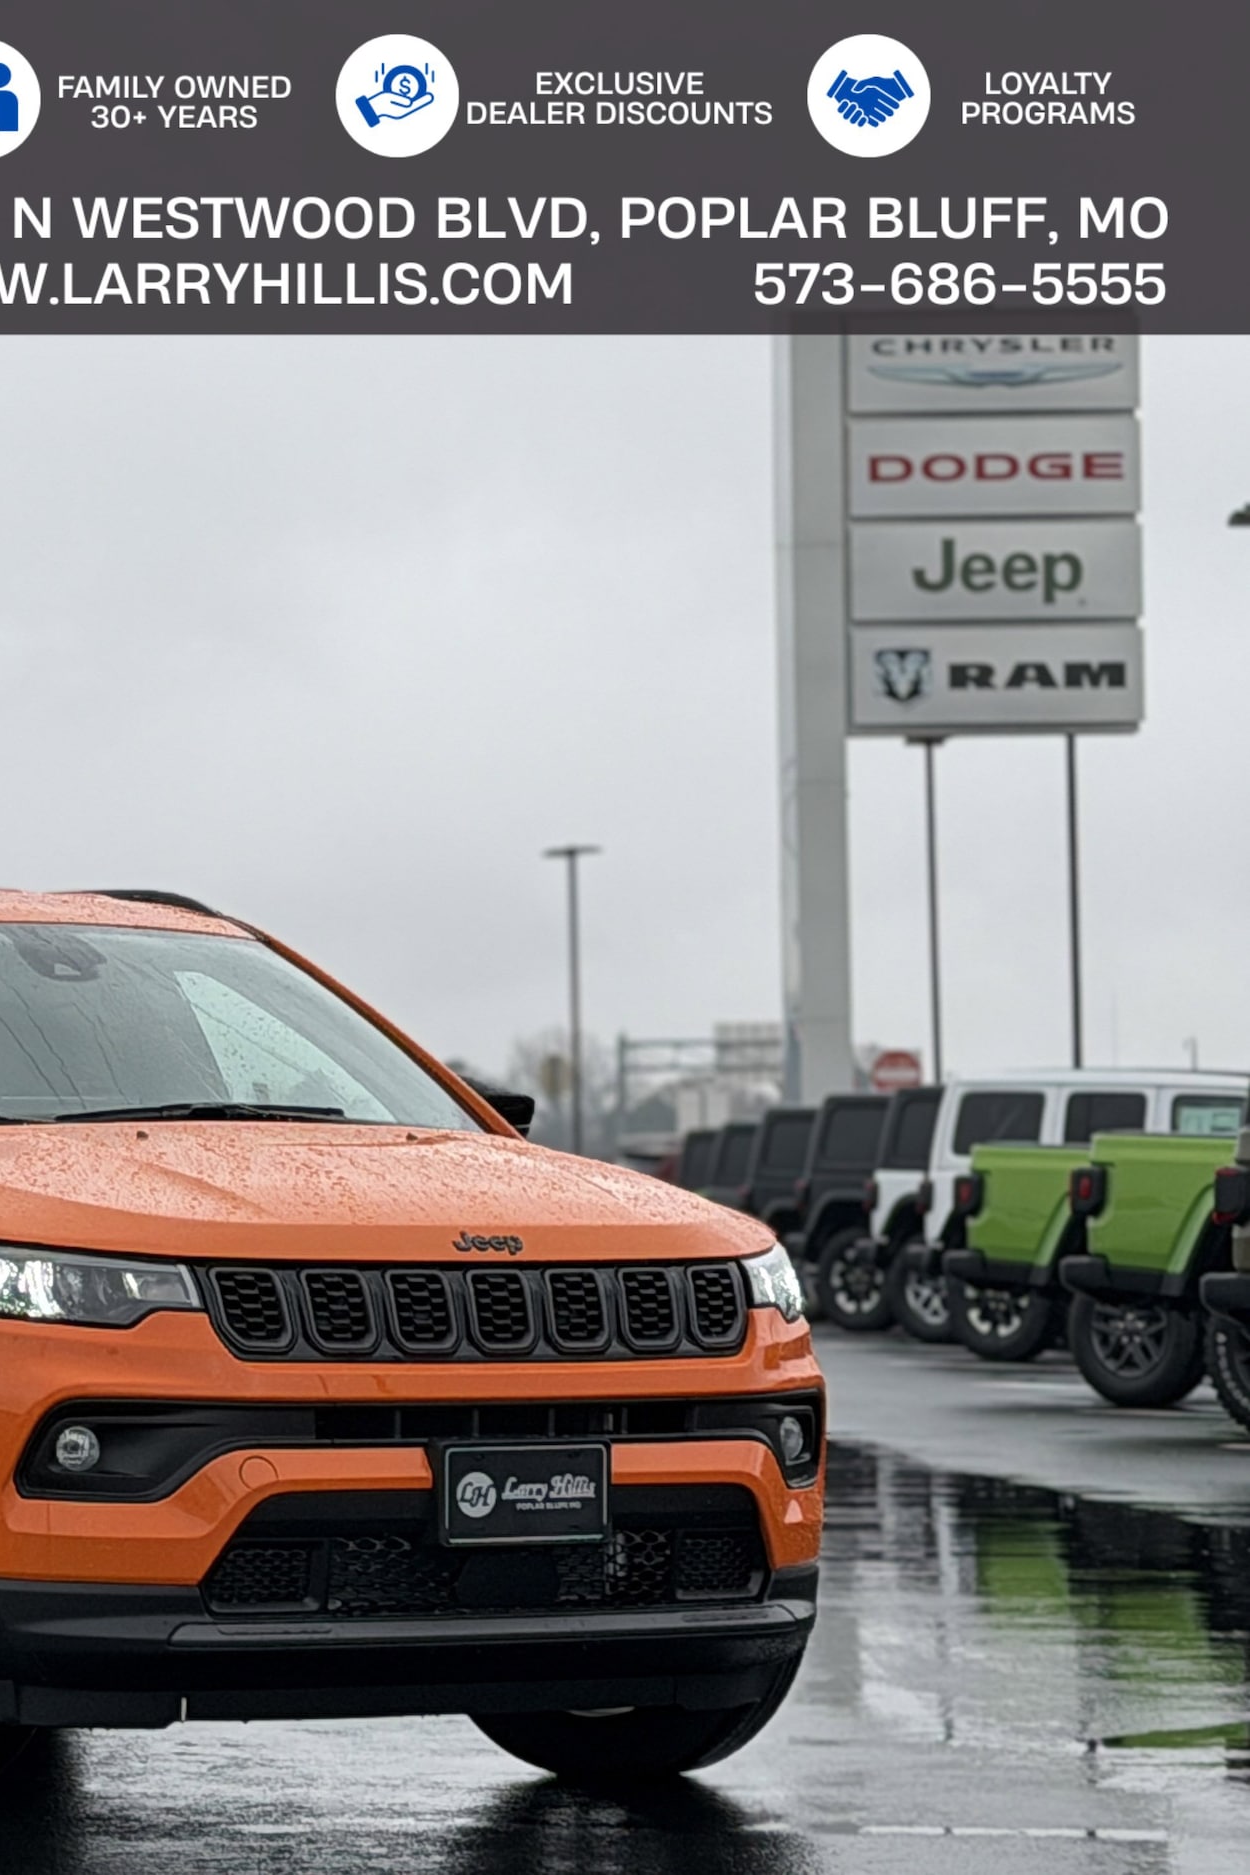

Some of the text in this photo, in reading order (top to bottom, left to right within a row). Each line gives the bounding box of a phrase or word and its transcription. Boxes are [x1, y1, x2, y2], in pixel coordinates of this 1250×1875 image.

[871, 337, 1116, 355] CHRYSLER
[868, 453, 1124, 483] DODGE
[912, 538, 1084, 604] Jeep
[948, 662, 1126, 690] RAM
[452, 1231, 523, 1255] Jeep
